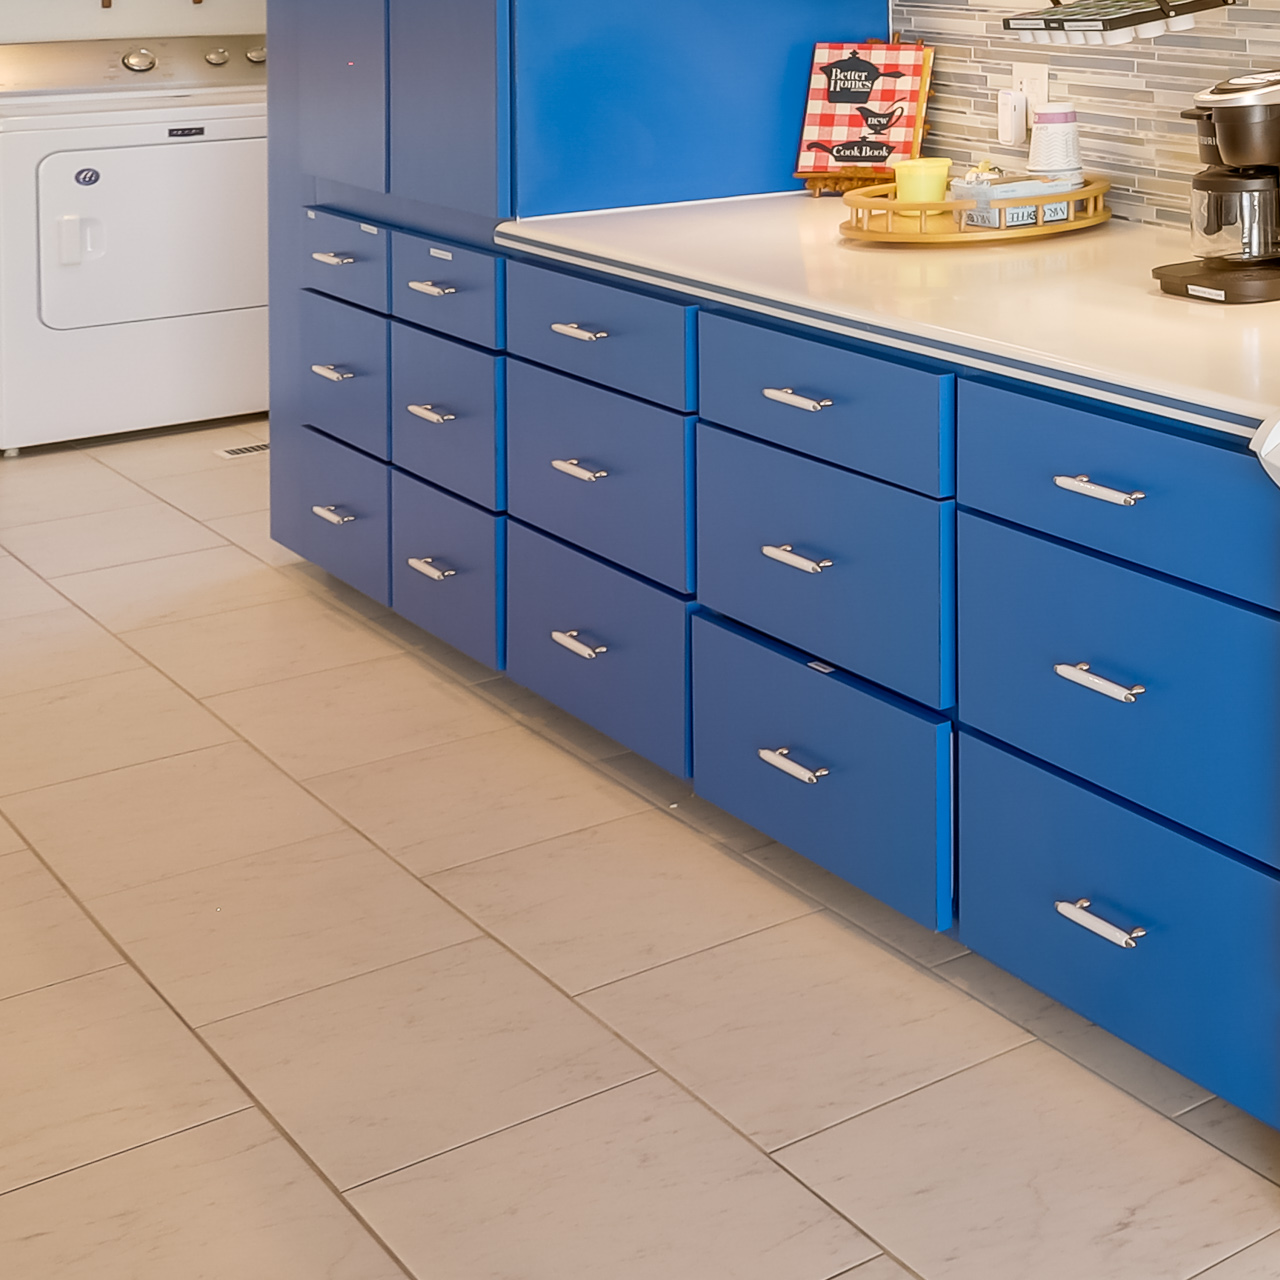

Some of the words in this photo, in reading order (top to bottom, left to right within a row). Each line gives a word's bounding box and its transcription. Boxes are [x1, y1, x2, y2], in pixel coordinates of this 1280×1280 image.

[831, 67, 868, 80] Better
[829, 80, 873, 91] Homes
[832, 146, 861, 156] Cook
[861, 146, 889, 157] Book
